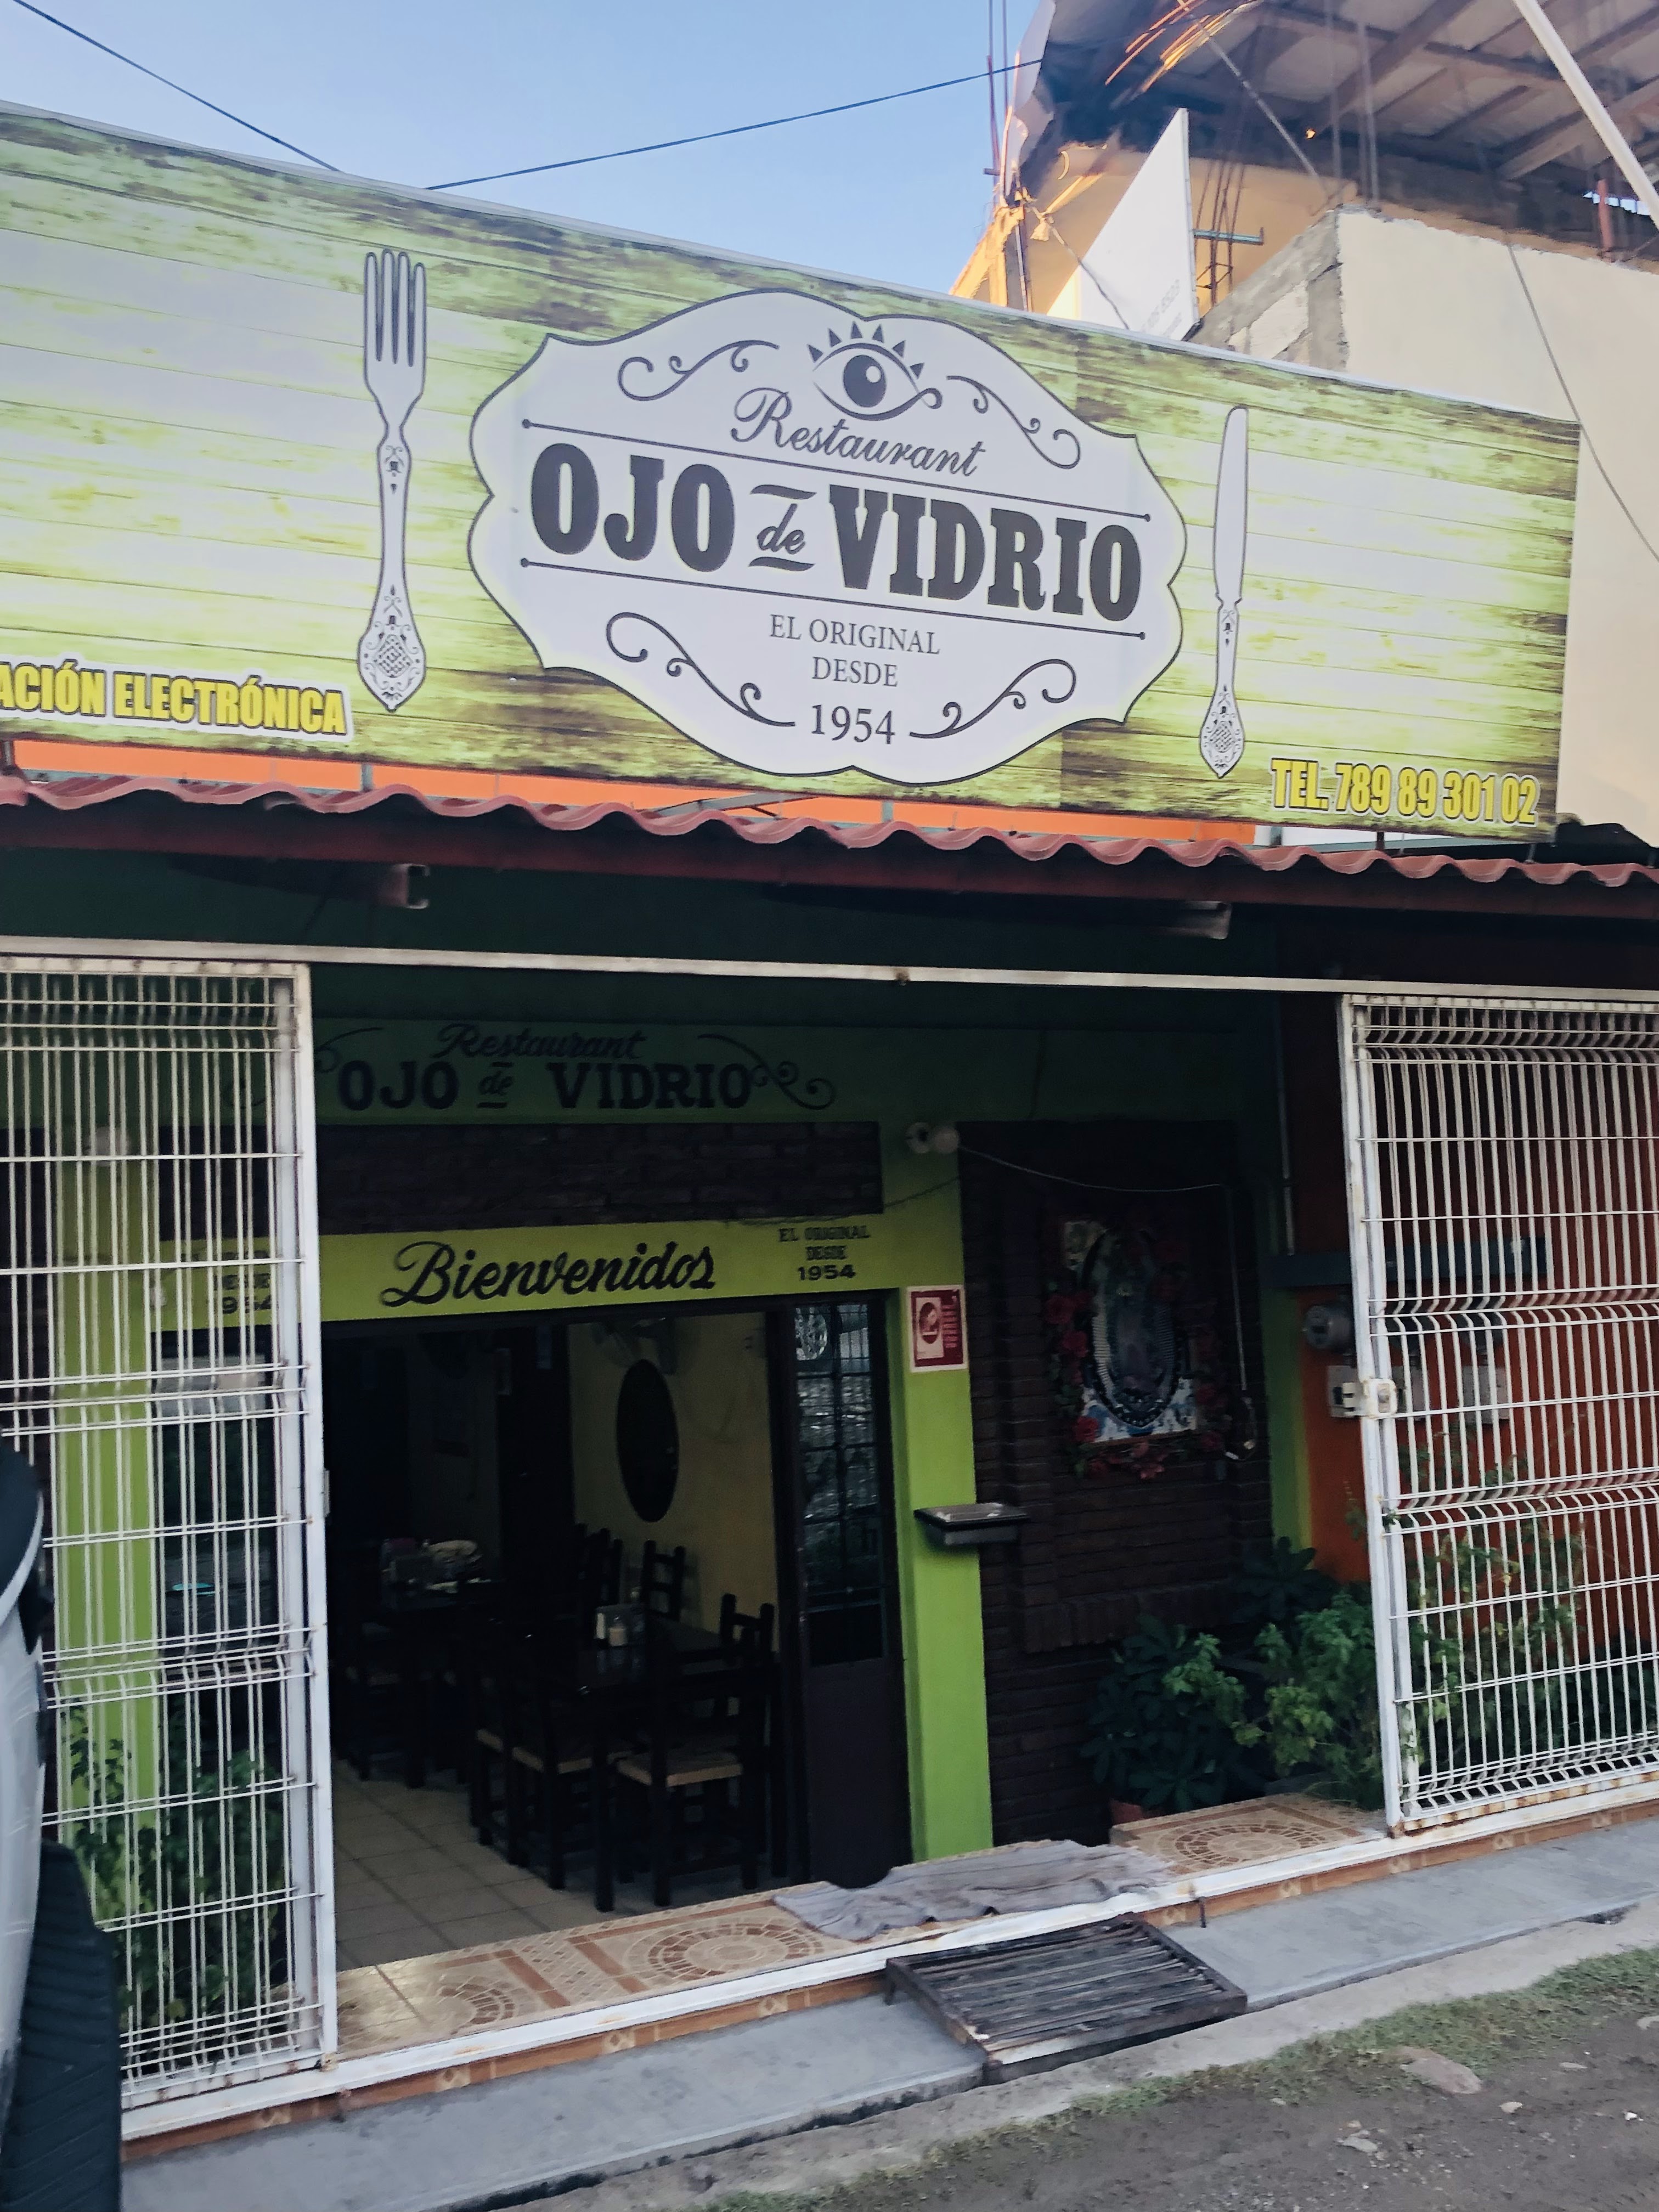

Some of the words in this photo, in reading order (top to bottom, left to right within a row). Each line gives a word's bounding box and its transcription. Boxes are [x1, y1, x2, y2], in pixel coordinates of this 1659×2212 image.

[731, 387, 986, 476] Restaurant
[532, 443, 734, 572] OJO
[757, 503, 806, 555] de
[829, 484, 1141, 622] VIDRIO
[770, 614, 802, 640] EL
[809, 618, 940, 654] ORIGINAL
[812, 657, 898, 687] DESDE
[112, 671, 347, 735] ELECTRÓNICA
[811, 704, 895, 744] 1954
[1271, 757, 1329, 811] TEL.
[1335, 762, 1392, 815] 789
[1397, 767, 1437, 817] 89
[1443, 771, 1495, 821] 301
[1500, 776, 1536, 825] 02
[432, 1023, 647, 1059] Restaurant
[337, 1059, 459, 1111] OJO
[479, 1070, 513, 1096] de
[546, 1062, 753, 1109] VIDRIO
[380, 1240, 715, 1307] Bienvenidos
[798, 1264, 856, 1280] 1954
